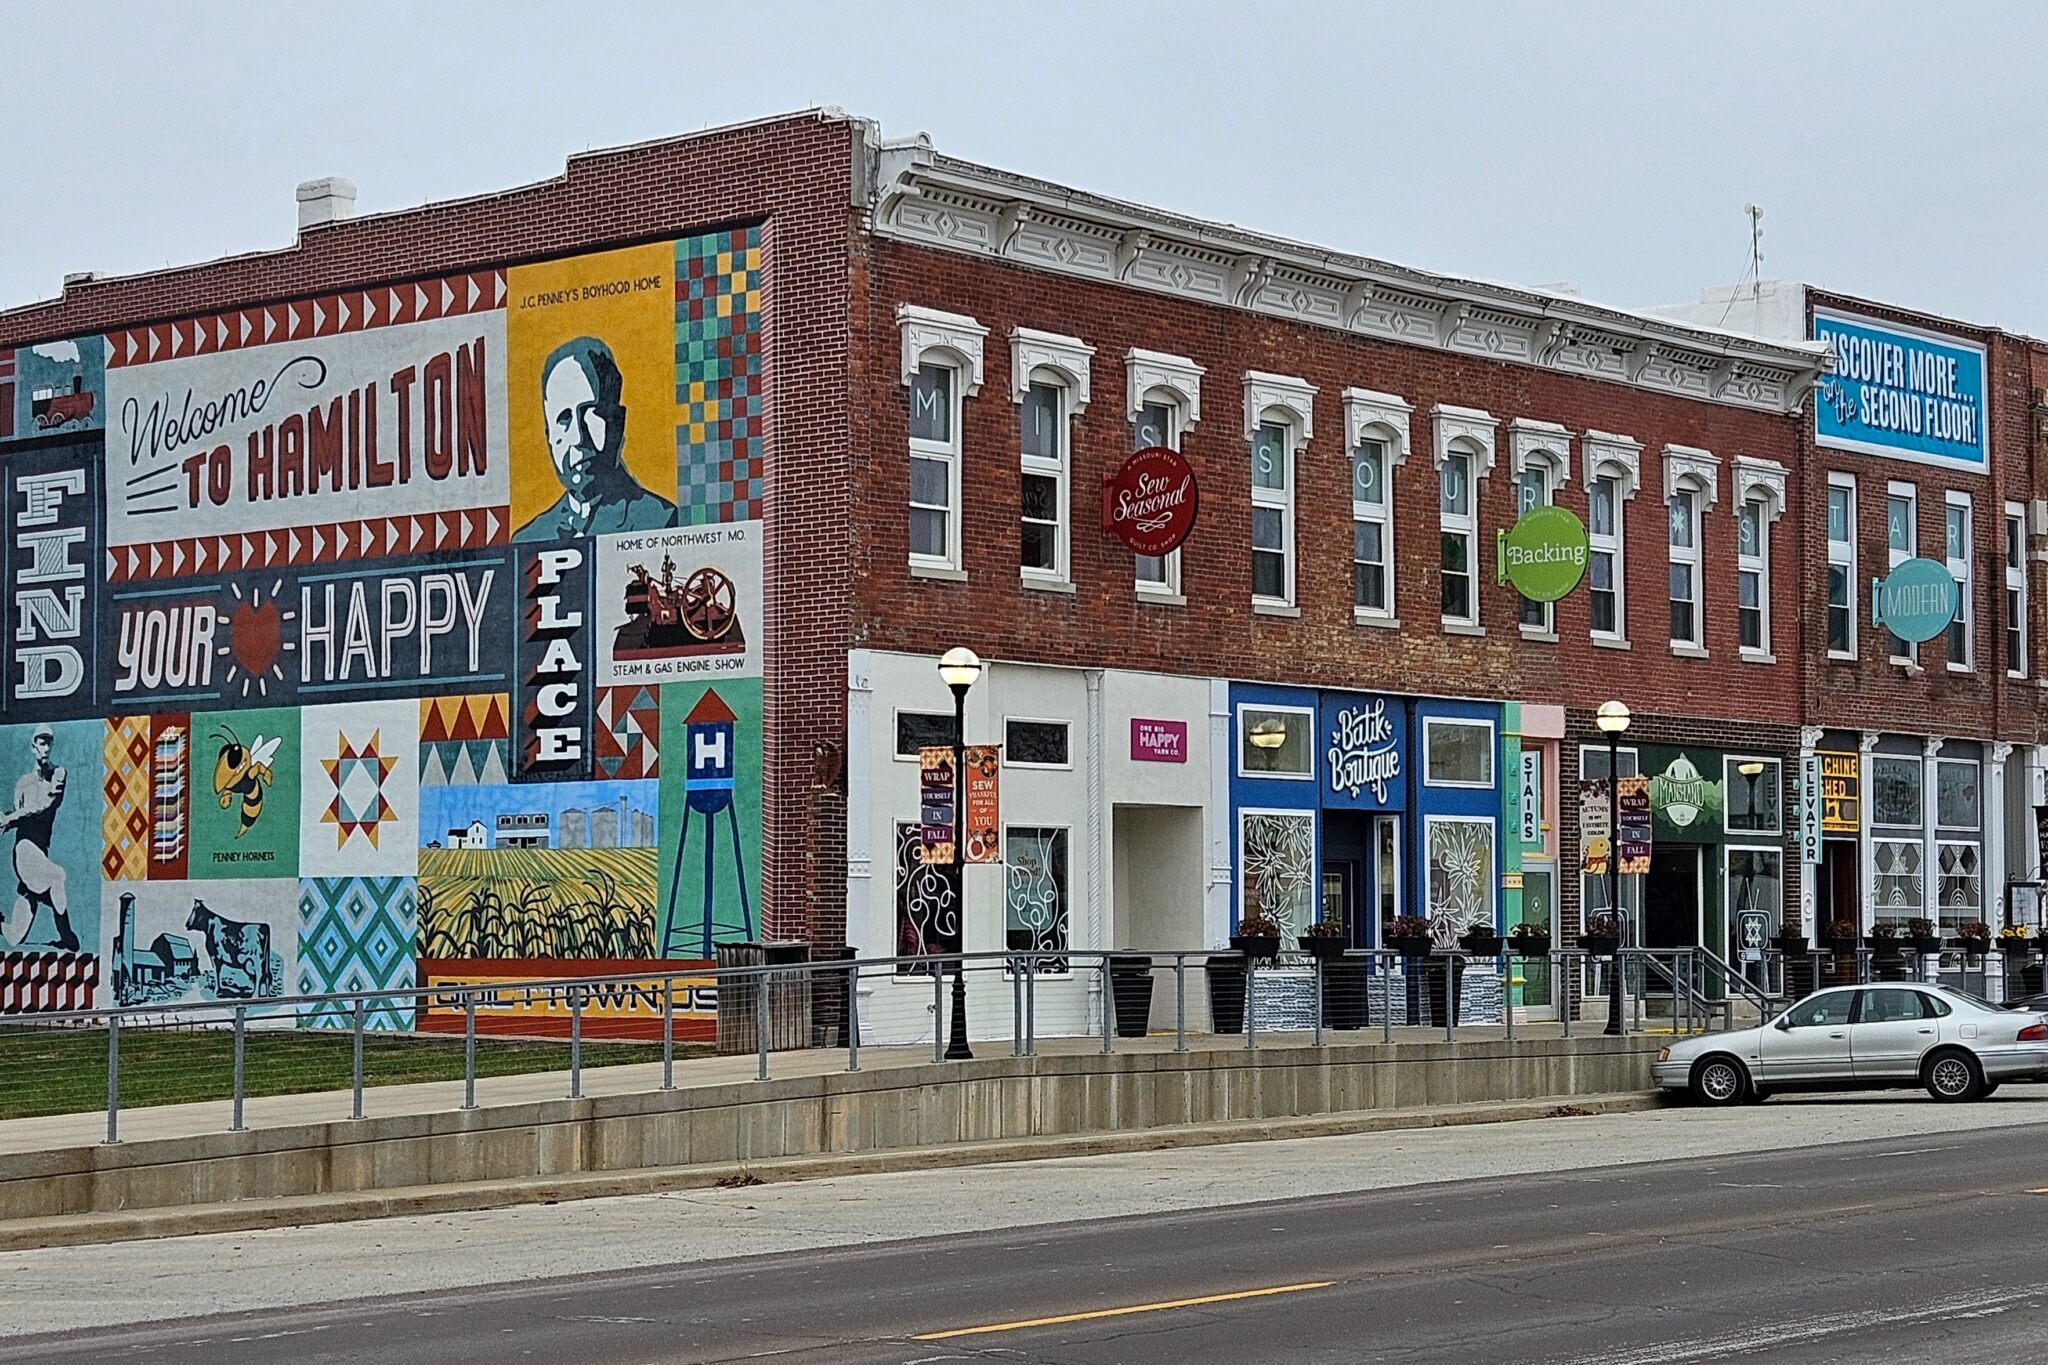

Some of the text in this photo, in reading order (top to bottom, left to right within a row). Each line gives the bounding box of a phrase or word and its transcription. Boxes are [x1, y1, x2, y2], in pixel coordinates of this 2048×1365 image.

[537, 286, 579, 307] PENNEY'S
[582, 280, 631, 301] BOYHOOD
[633, 275, 662, 290] HOME
[1820, 330, 1975, 404] ISCOVER MORE...
[1822, 378, 1842, 402] on
[122, 356, 327, 466] Welcome
[1834, 388, 1857, 424] the
[1860, 385, 1978, 445] SECOND FLOOR!
[182, 336, 488, 508] TO HAMILTON
[916, 387, 937, 421] M
[1140, 425, 1155, 449] S
[1258, 445, 1273, 474] S
[1356, 461, 1374, 489] O
[1443, 472, 1459, 501] U
[1523, 486, 1536, 511] R
[1740, 518, 1751, 543] S
[1132, 452, 1162, 466] MISSOURI
[1163, 454, 1178, 467] STAR
[1135, 472, 1170, 498] Sew
[1113, 474, 1191, 521] Seasonal
[1830, 505, 1959, 547] T A R
[616, 530, 747, 551] HOME OF NORTHWEST MO.
[1129, 537, 1146, 550] QUILT
[1160, 533, 1176, 549] SHOP
[1507, 542, 1585, 566] Backing
[15, 469, 87, 699] FIND
[1887, 583, 1949, 617] MODERN
[115, 569, 496, 692] YOUR HAPPY
[533, 548, 583, 764] PLACE
[612, 657, 746, 677] STEAM & GAS ENGINE SHOW
[1154, 725, 1165, 733] BIG
[1338, 698, 1388, 752] Batik
[694, 732, 726, 770] H
[1139, 732, 1180, 749] HAPPY
[924, 771, 951, 782] WRAP
[1328, 740, 1401, 804] Boutique
[1820, 757, 1858, 776] CHINE
[923, 792, 952, 800] YOURSELF
[972, 780, 994, 790] SEW
[1523, 755, 1533, 839] STAIRS
[1582, 805, 1609, 813] AUTUMN
[1622, 798, 1647, 807] WRAP
[1805, 760, 1816, 860] ELEVATOR
[932, 811, 942, 821] IN
[974, 816, 993, 826] YOU
[927, 830, 948, 840] FALL
[1631, 830, 1641, 839] IN
[212, 851, 275, 863] PENNEY HORNETS
[1626, 846, 1646, 854] FALL
